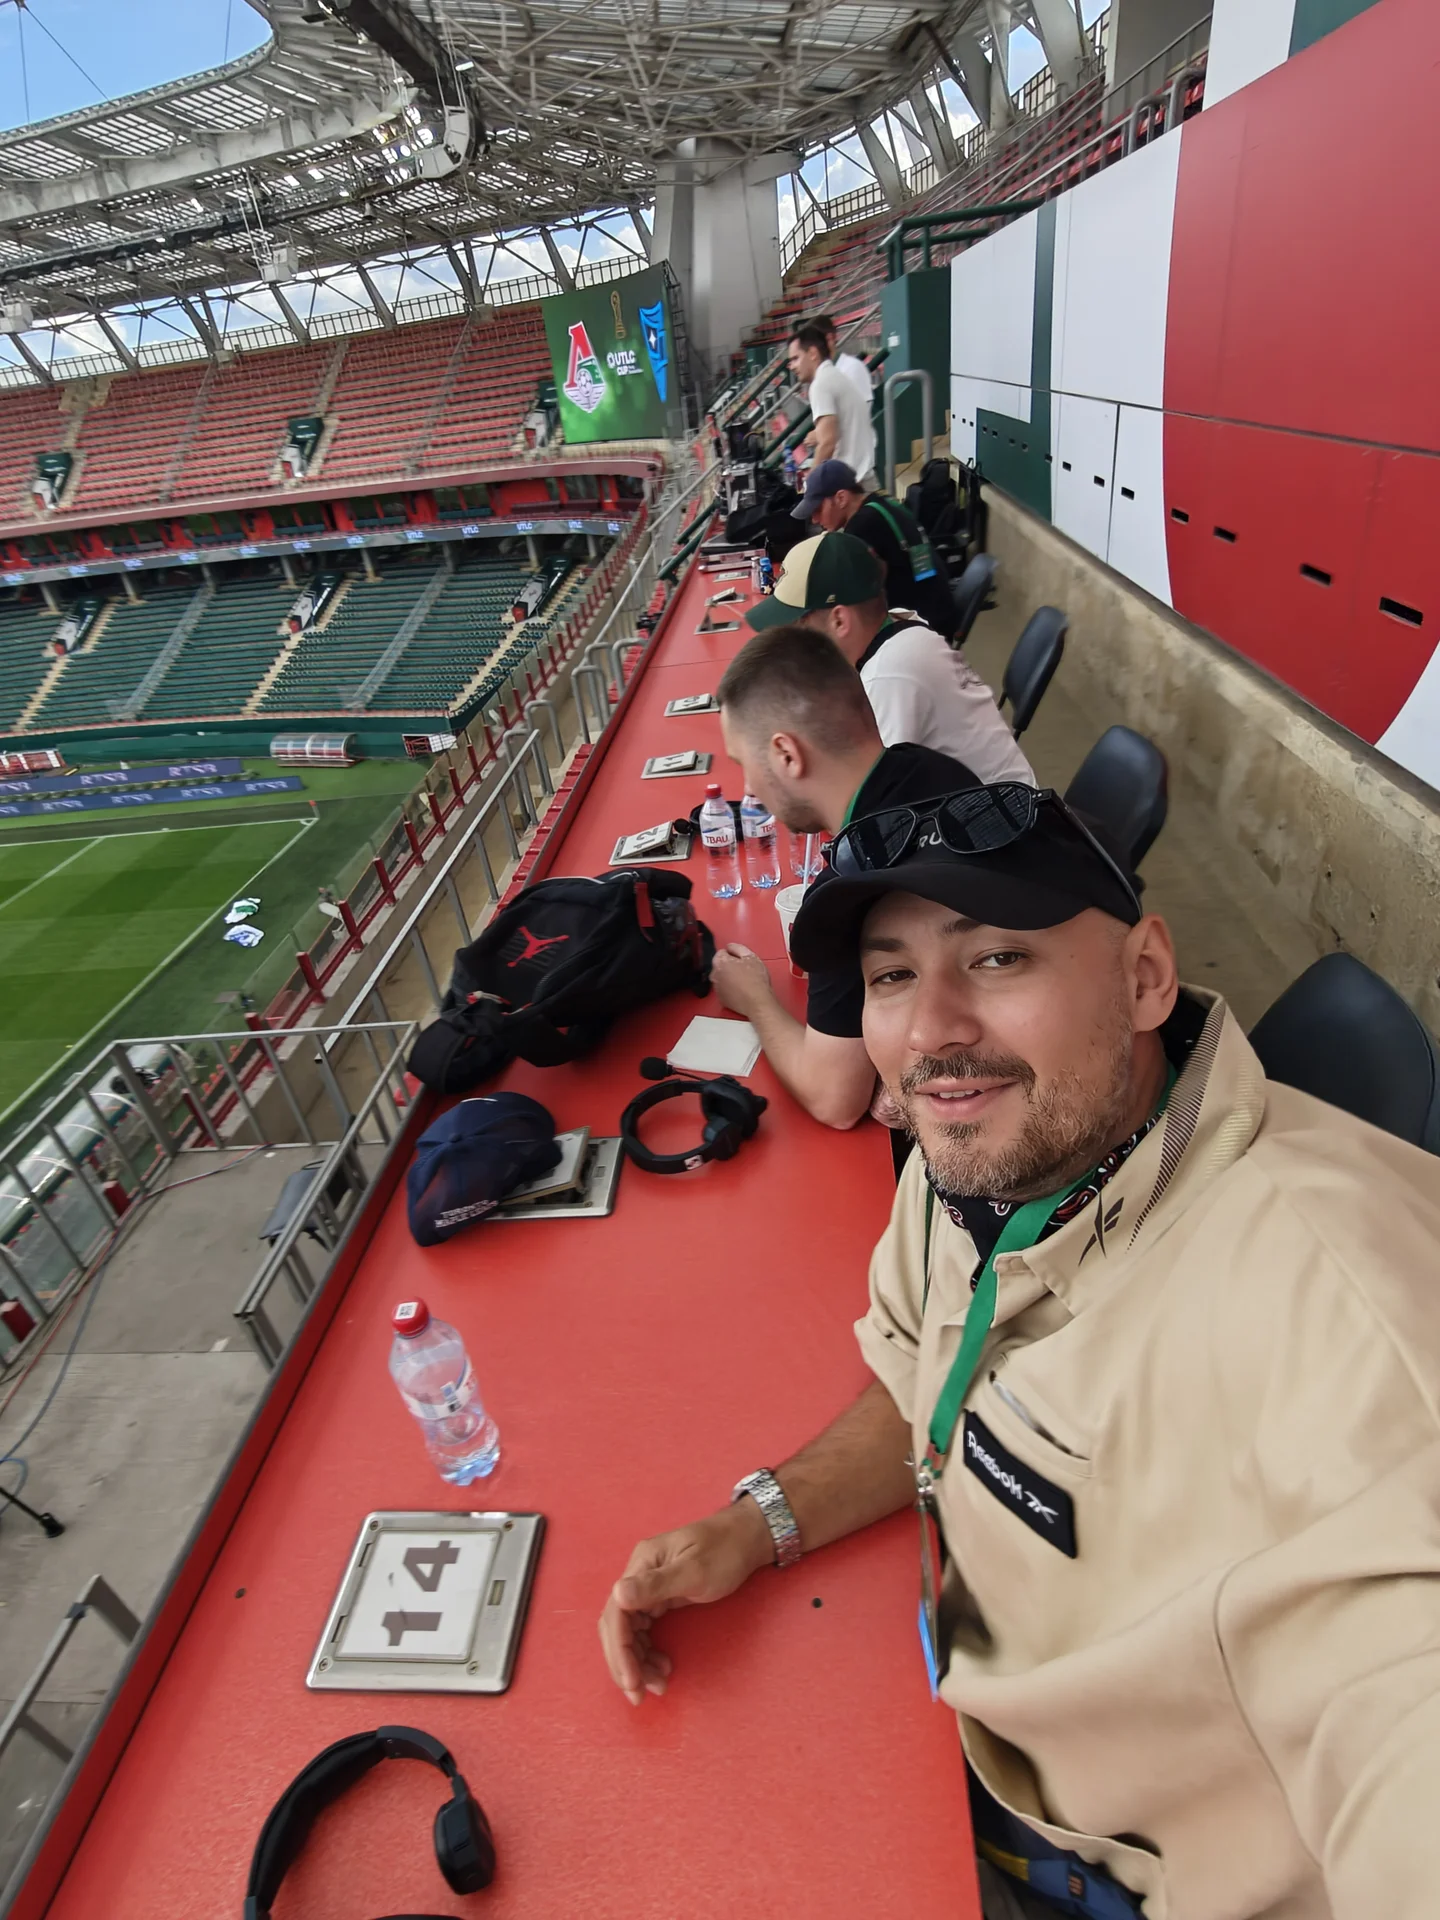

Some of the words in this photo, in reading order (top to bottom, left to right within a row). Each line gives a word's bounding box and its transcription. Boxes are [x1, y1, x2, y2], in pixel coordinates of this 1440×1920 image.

[615, 350, 636, 365] UTLC
[663, 754, 685, 767] 11
[633, 827, 660, 850] 12
[967, 1430, 1023, 1500] Reebok
[381, 1540, 461, 1647] 14
